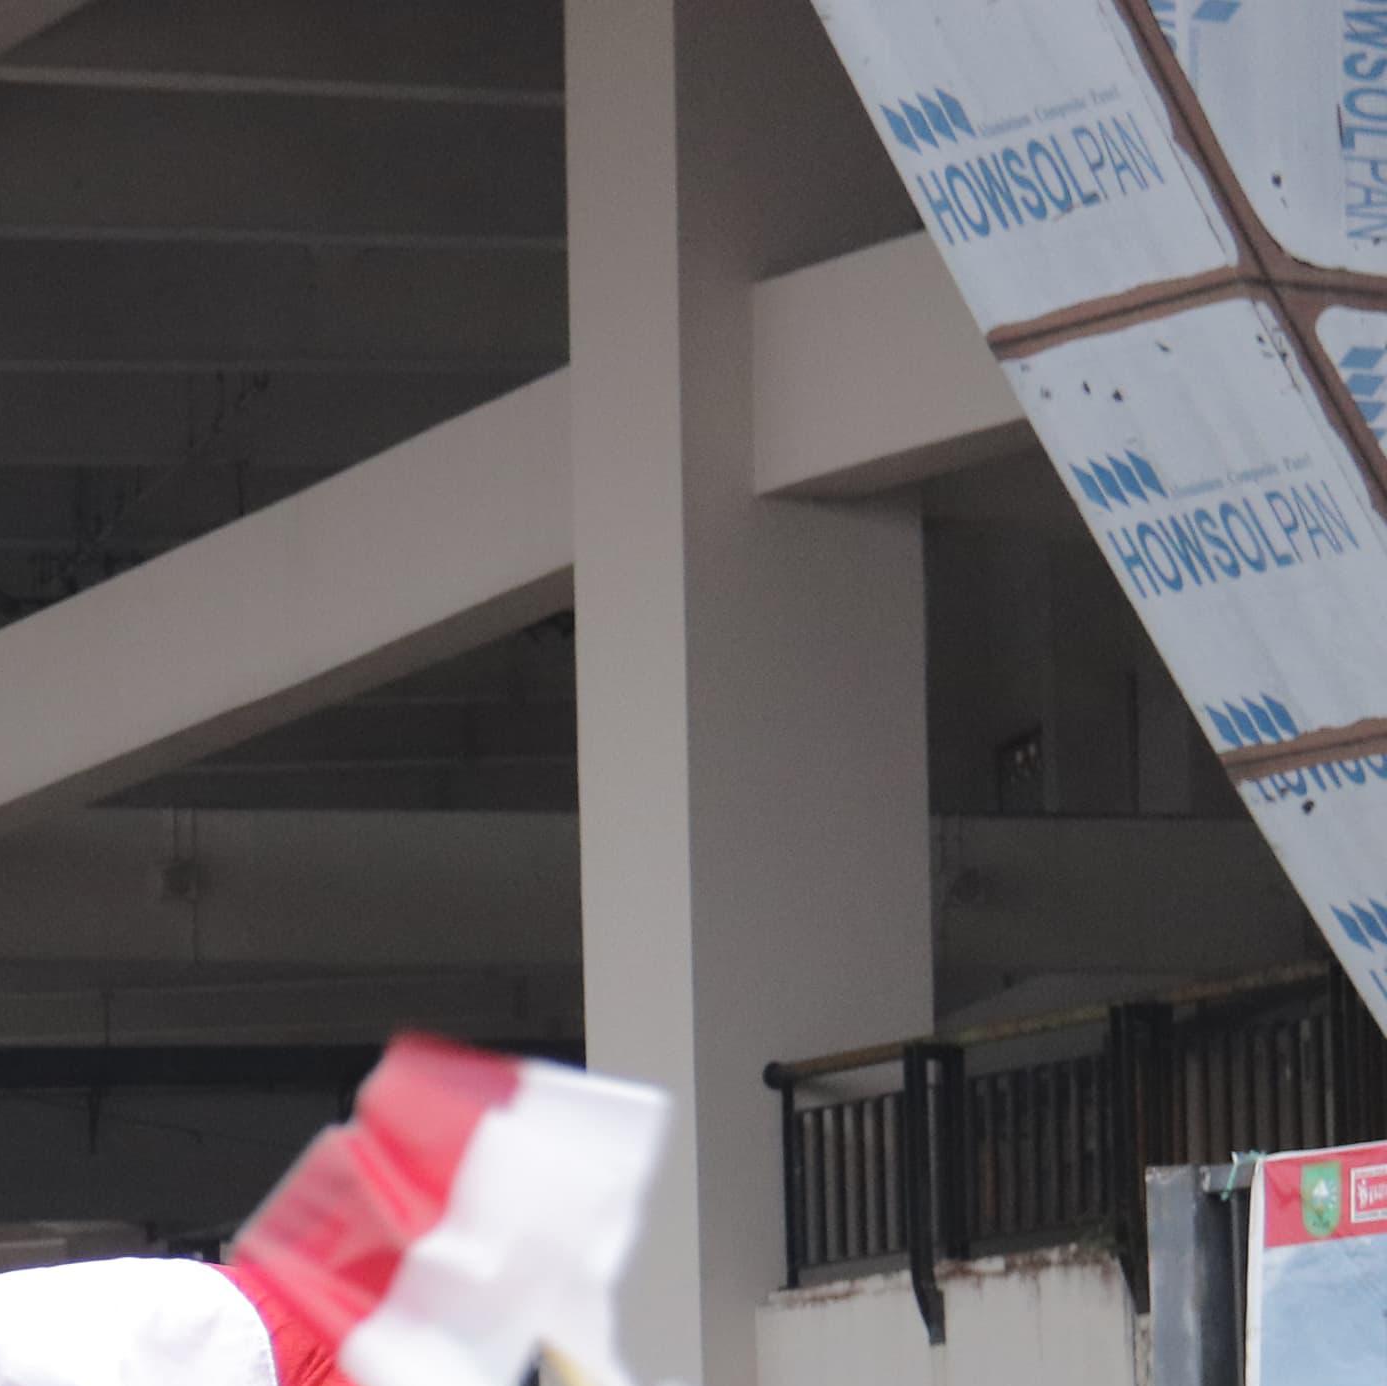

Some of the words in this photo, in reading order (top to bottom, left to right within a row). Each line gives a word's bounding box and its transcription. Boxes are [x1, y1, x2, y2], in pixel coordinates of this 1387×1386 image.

[917, 111, 1165, 246] HOWSOLPAN
[1341, 0, 1387, 240] WSOLPAN
[1107, 480, 1361, 600] HOWSOLPAN
